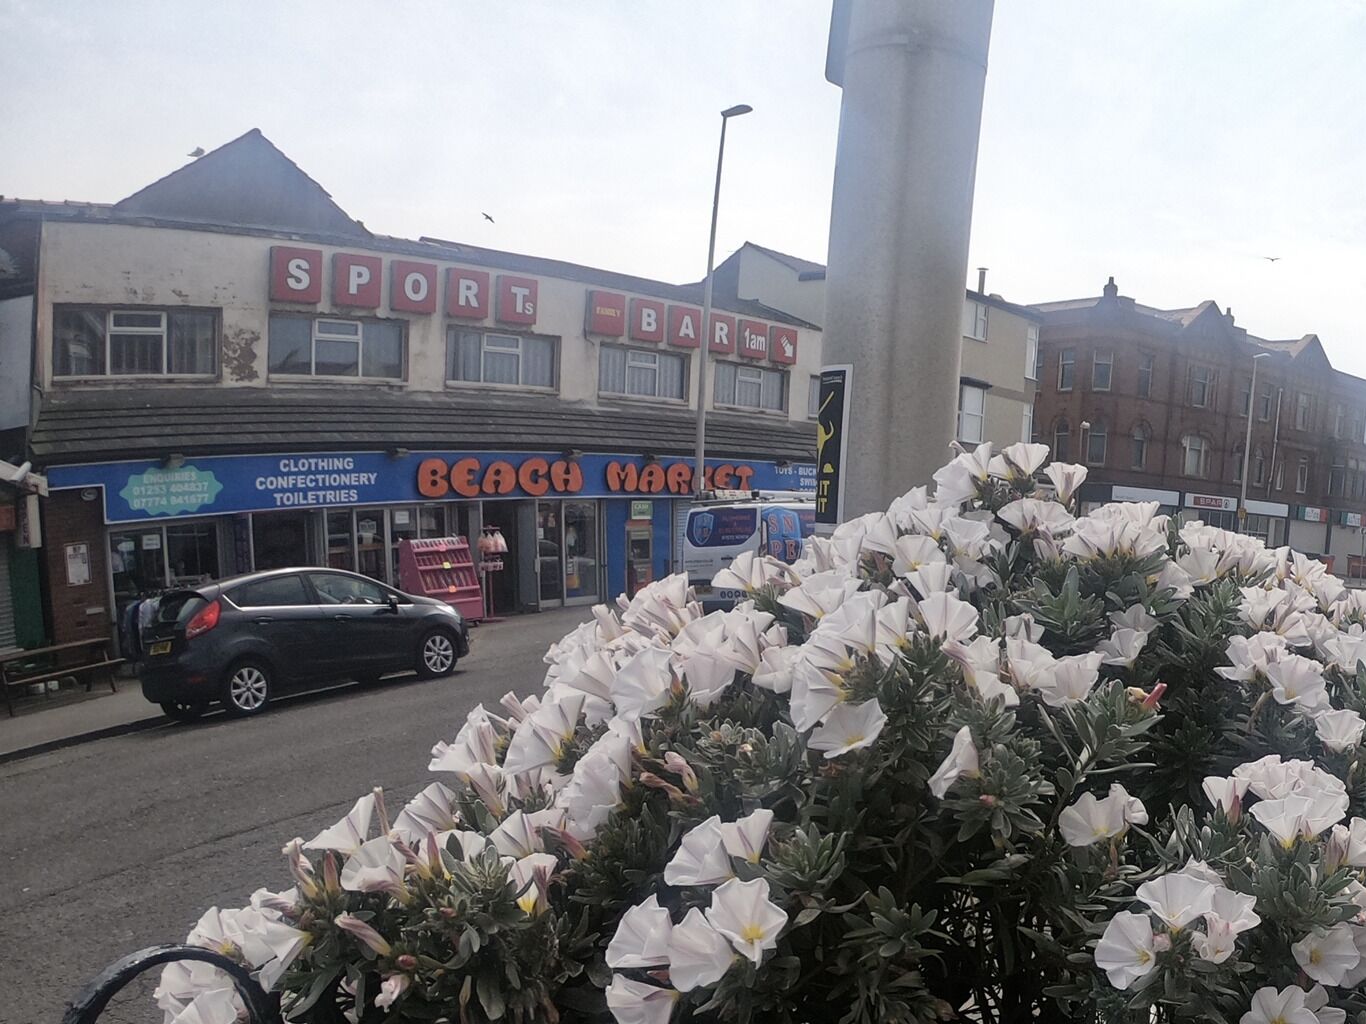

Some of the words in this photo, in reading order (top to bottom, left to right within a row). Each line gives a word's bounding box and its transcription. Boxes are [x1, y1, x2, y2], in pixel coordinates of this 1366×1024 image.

[641, 307, 729, 345] BAR
[744, 327, 766, 352] 1am
[279, 457, 354, 472] CLOTHING
[255, 472, 378, 490] CONFECTIONERY
[418, 456, 584, 498] BEACH
[273, 489, 359, 506] TOILETRIES
